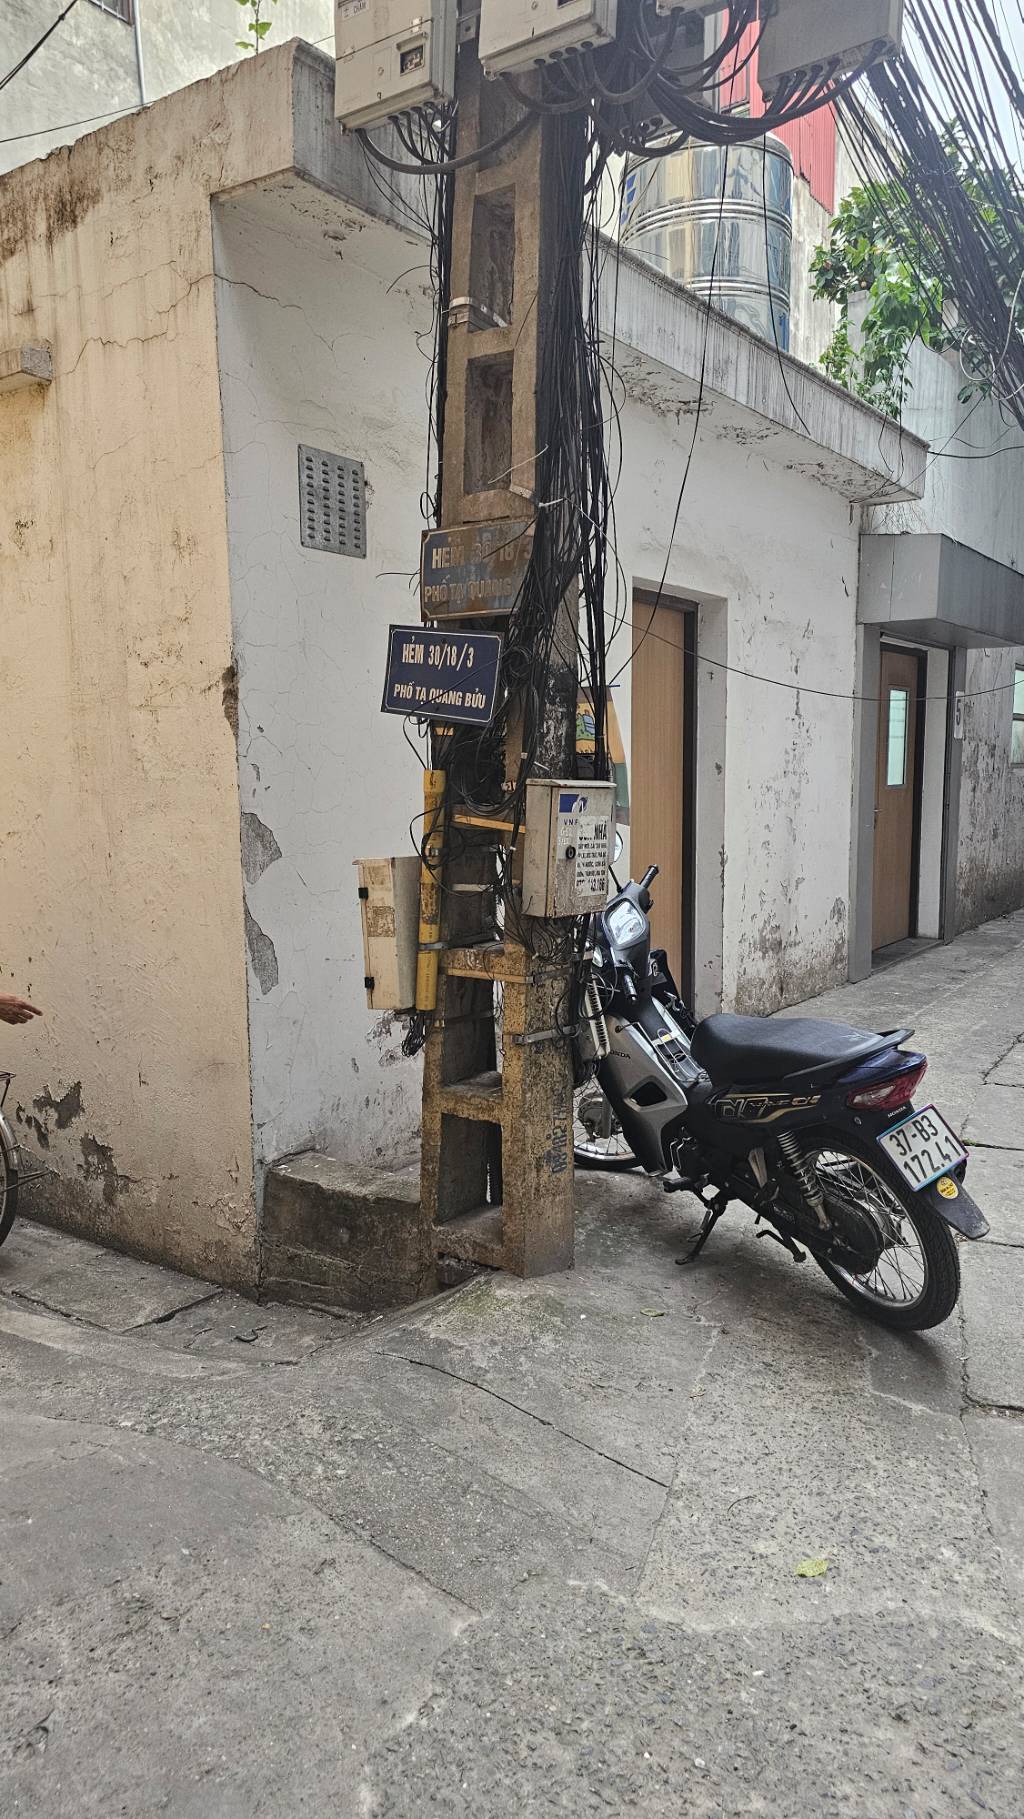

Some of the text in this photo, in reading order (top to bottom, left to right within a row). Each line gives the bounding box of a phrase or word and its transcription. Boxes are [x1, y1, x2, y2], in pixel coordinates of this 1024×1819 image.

[402, 635, 475, 671] HẺM 30/18/3
[393, 681, 487, 709] PHỐ TẠ QUANG BỬU
[563, 818, 580, 826] VNP
[609, 1049, 632, 1060] ONDA
[887, 1105, 907, 1118] HONDA
[889, 1114, 939, 1156] 37-B3
[903, 1135, 962, 1183] 172.41
